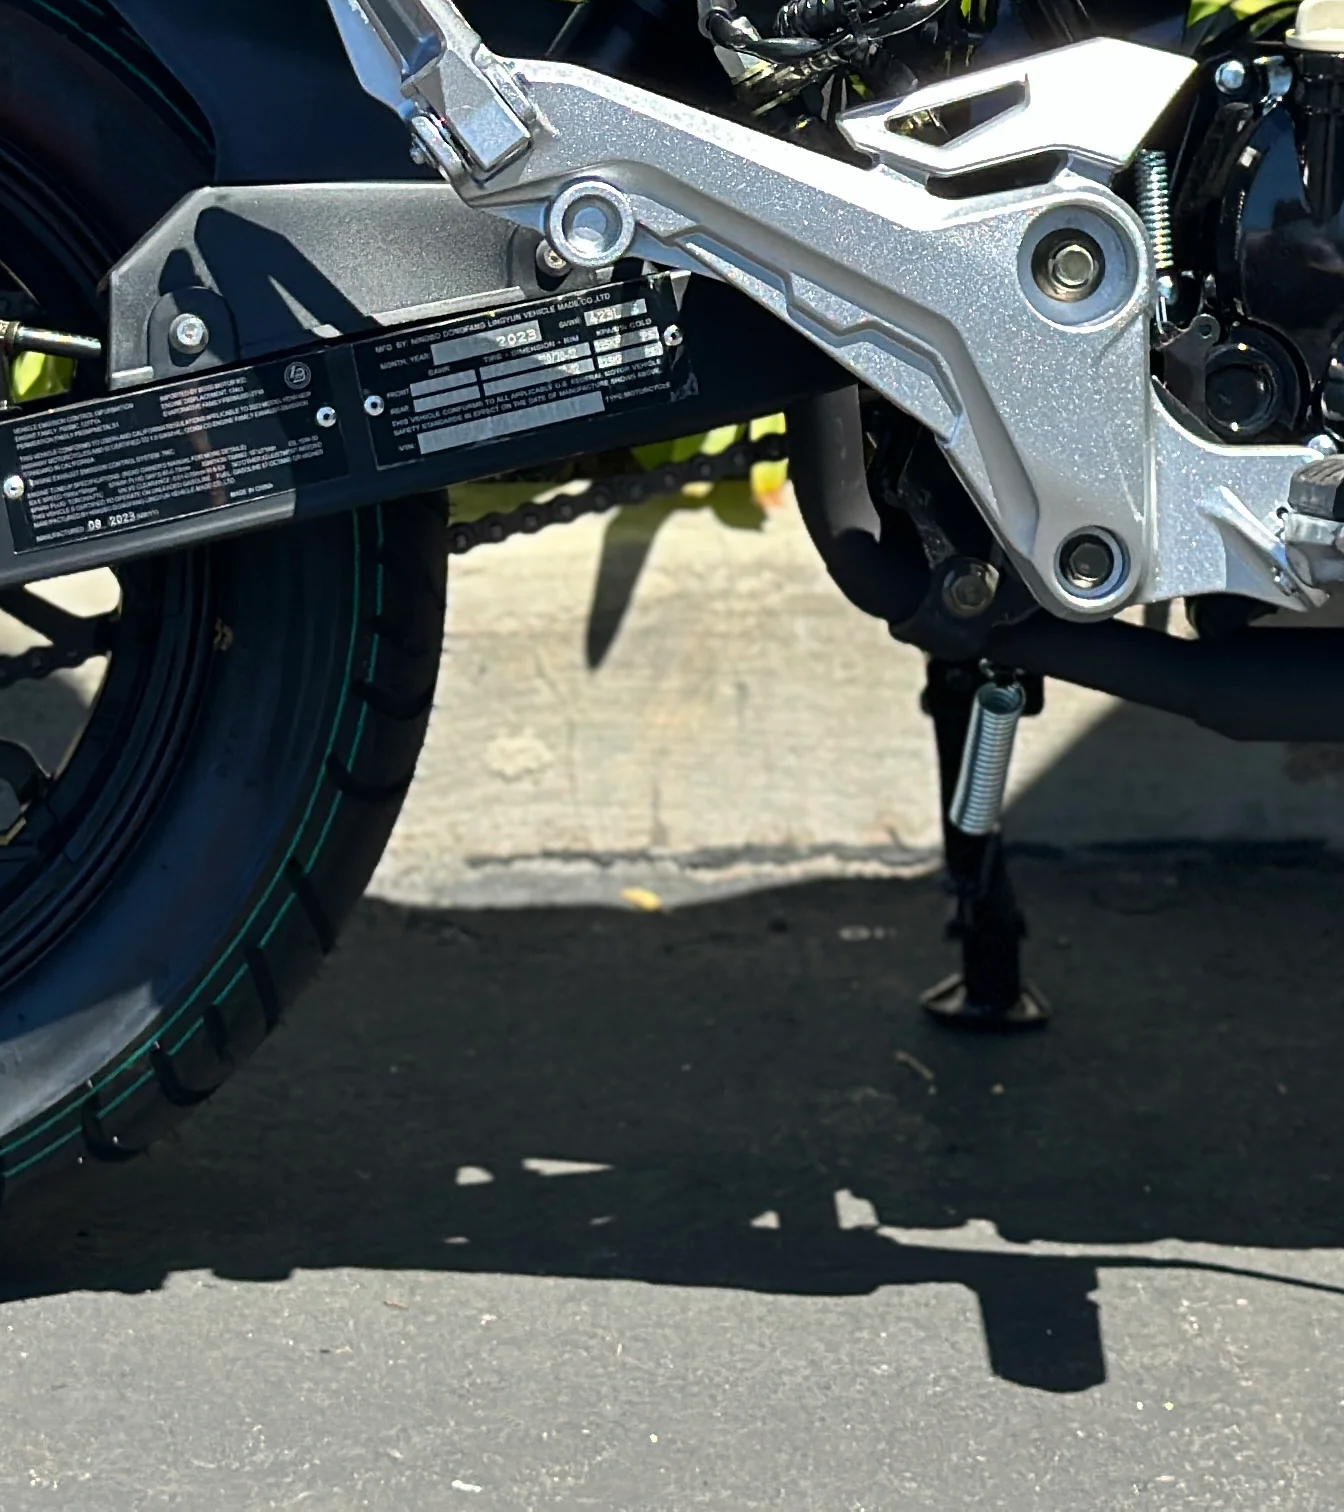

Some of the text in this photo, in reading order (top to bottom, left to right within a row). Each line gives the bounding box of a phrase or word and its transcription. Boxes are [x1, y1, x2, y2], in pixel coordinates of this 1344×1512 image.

[522, 306, 555, 319] VEHICLE
[496, 328, 538, 348] 2023
[108, 510, 136, 526] 2023
